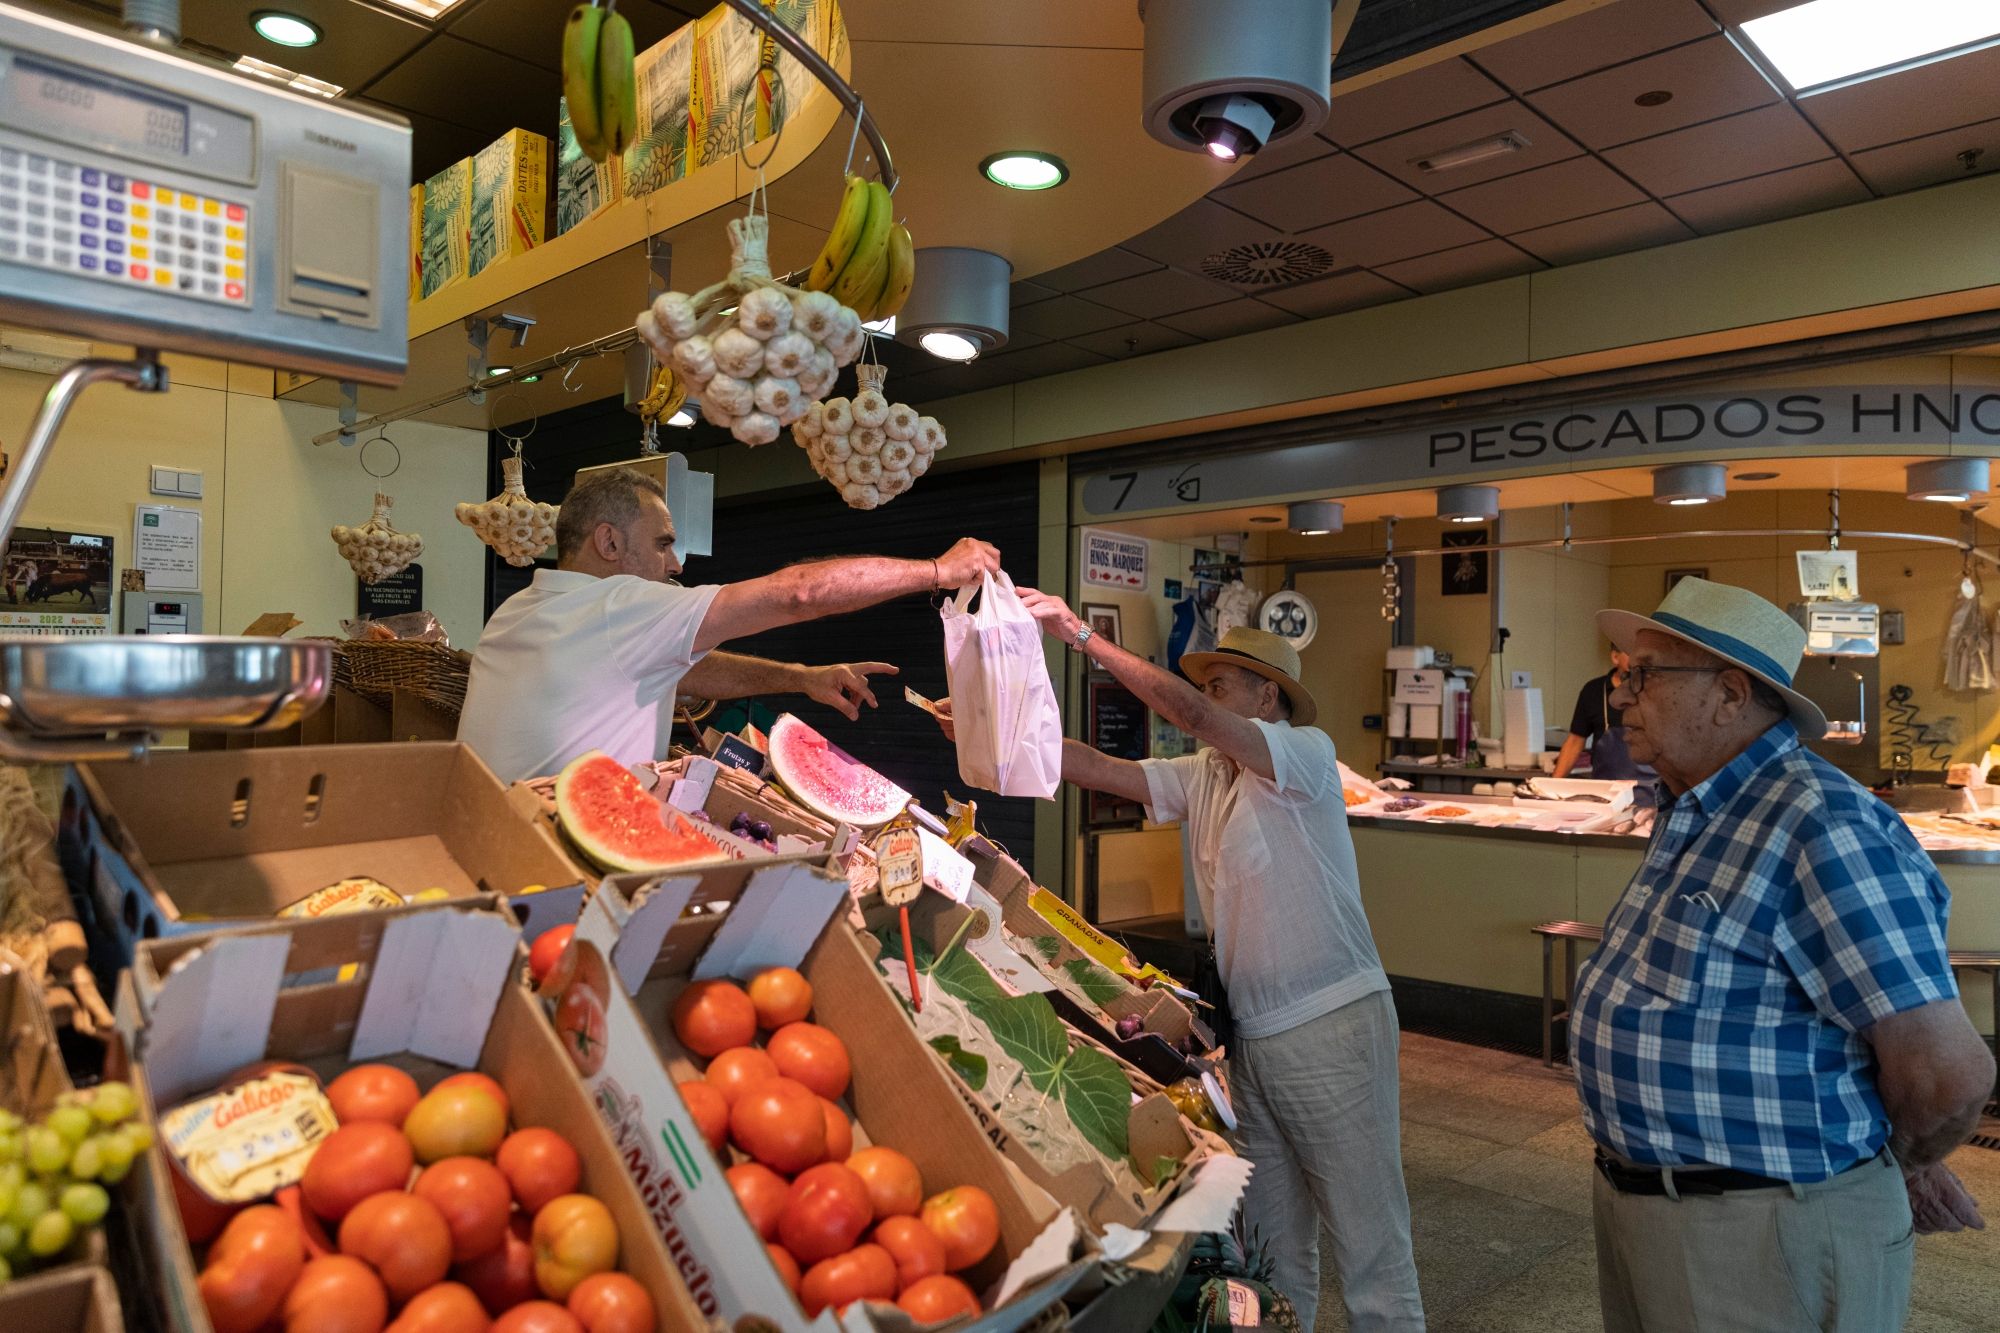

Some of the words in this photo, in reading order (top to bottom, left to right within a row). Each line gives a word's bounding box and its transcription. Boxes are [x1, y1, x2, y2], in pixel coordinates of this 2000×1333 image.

[518, 157, 528, 193] DATTES
[1428, 394, 1825, 468] PESCADOS
[1109, 473, 1138, 510] 7
[1090, 537, 1115, 552] PESCADOS
[1115, 542, 1119, 552] Y
[1119, 543, 1144, 557] MARISCOS
[1112, 553, 1144, 574] MARQUEZ
[40, 615, 64, 624] 2022
[723, 747, 745, 764] Frutas
[1056, 908, 1104, 945] GRANADAS
